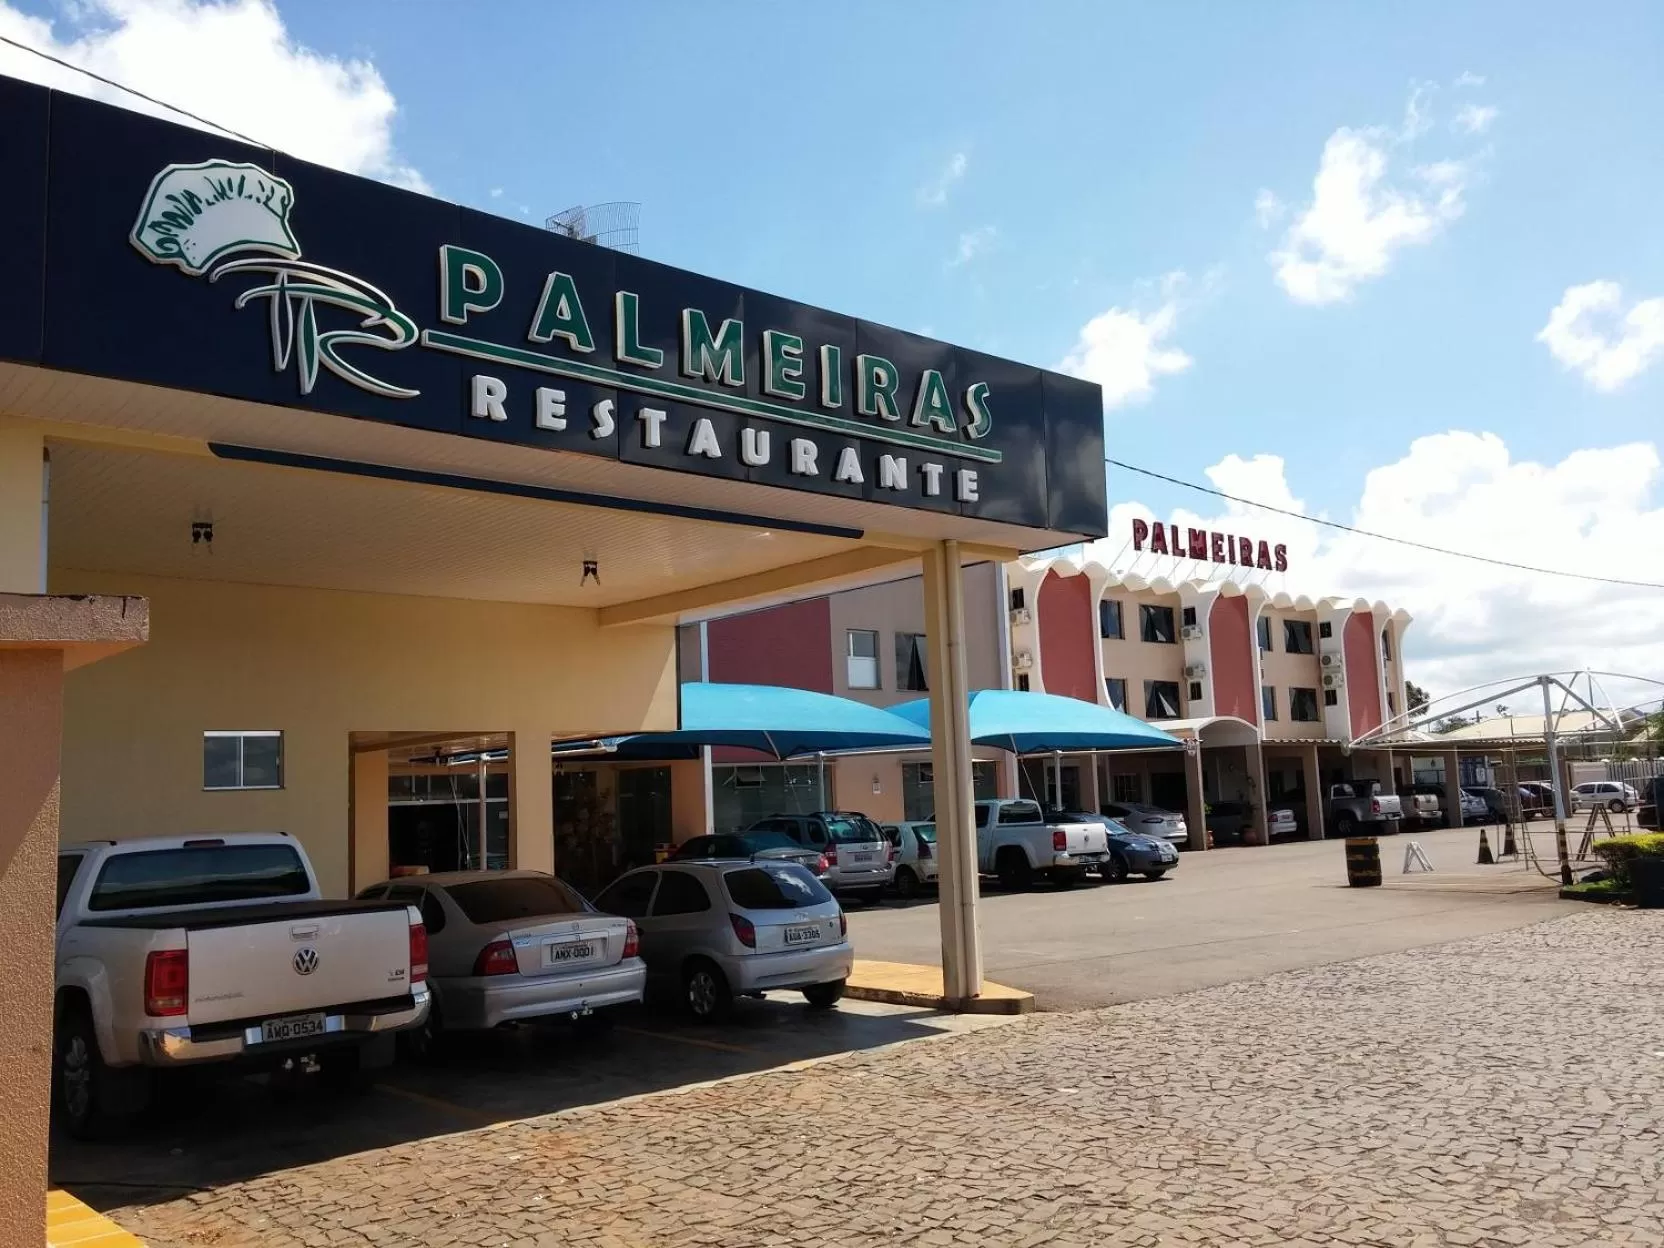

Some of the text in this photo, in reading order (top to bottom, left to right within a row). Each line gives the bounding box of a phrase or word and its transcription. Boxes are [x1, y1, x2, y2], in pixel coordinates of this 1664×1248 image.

[439, 244, 993, 440] PALMEIRAS
[471, 374, 979, 502] RESTAURANTE
[1132, 518, 1289, 573] PALMEIRAS
